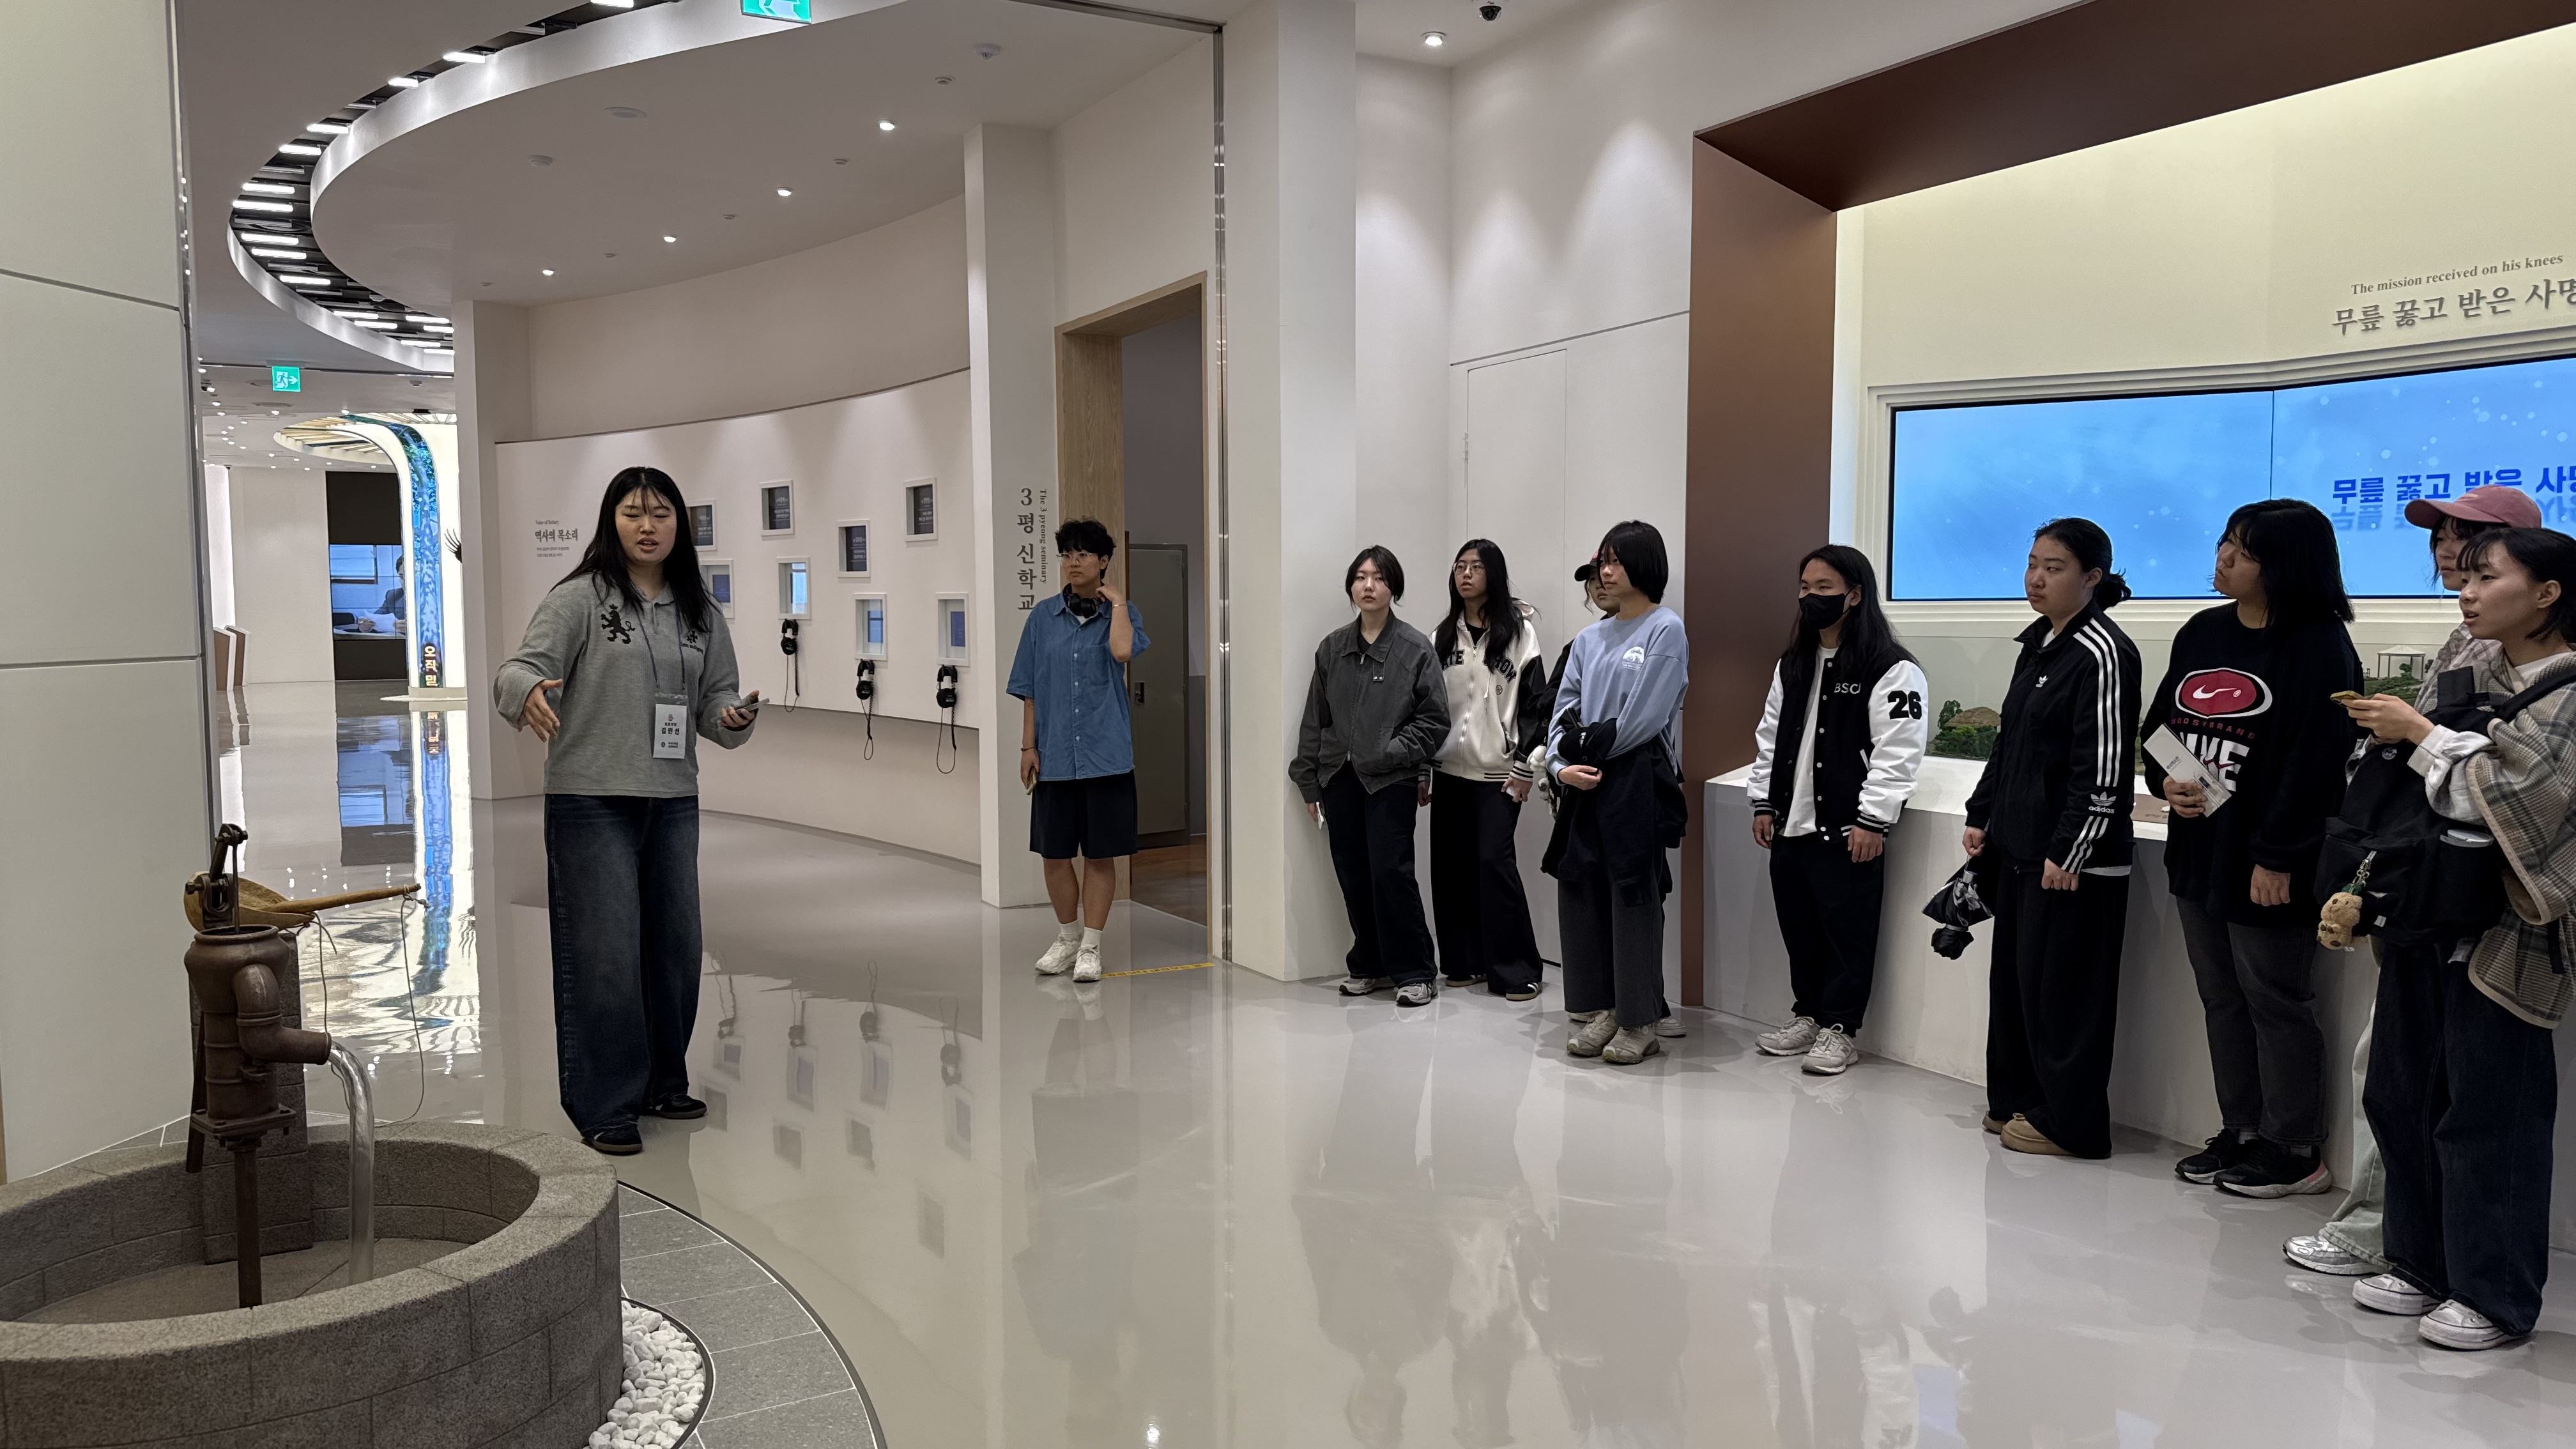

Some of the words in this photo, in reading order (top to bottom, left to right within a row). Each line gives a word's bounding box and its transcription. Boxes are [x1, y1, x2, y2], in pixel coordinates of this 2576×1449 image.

[2351, 284, 2373, 295] The
[2377, 275, 2422, 291] mission
[2426, 266, 2478, 284] received
[2481, 264, 2497, 275] on
[2502, 259, 2521, 272] his
[2525, 255, 2564, 268] knees
[2331, 304, 2384, 336] 무릎
[2392, 296, 2448, 328] 꿇고
[2458, 286, 2516, 319] 받은
[2333, 477, 2384, 505] 무릎
[2396, 473, 2451, 502] 꿇고
[2536, 466, 2576, 493] 사
[535, 529, 555, 542] 역사의
[557, 528, 578, 542] 목소리
[1017, 543, 1037, 610] 신학교
[1040, 546, 1048, 584] seminary
[1887, 690, 1922, 719] 26
[2179, 732, 2250, 792] IKE
[2088, 806, 2115, 814] adidas
